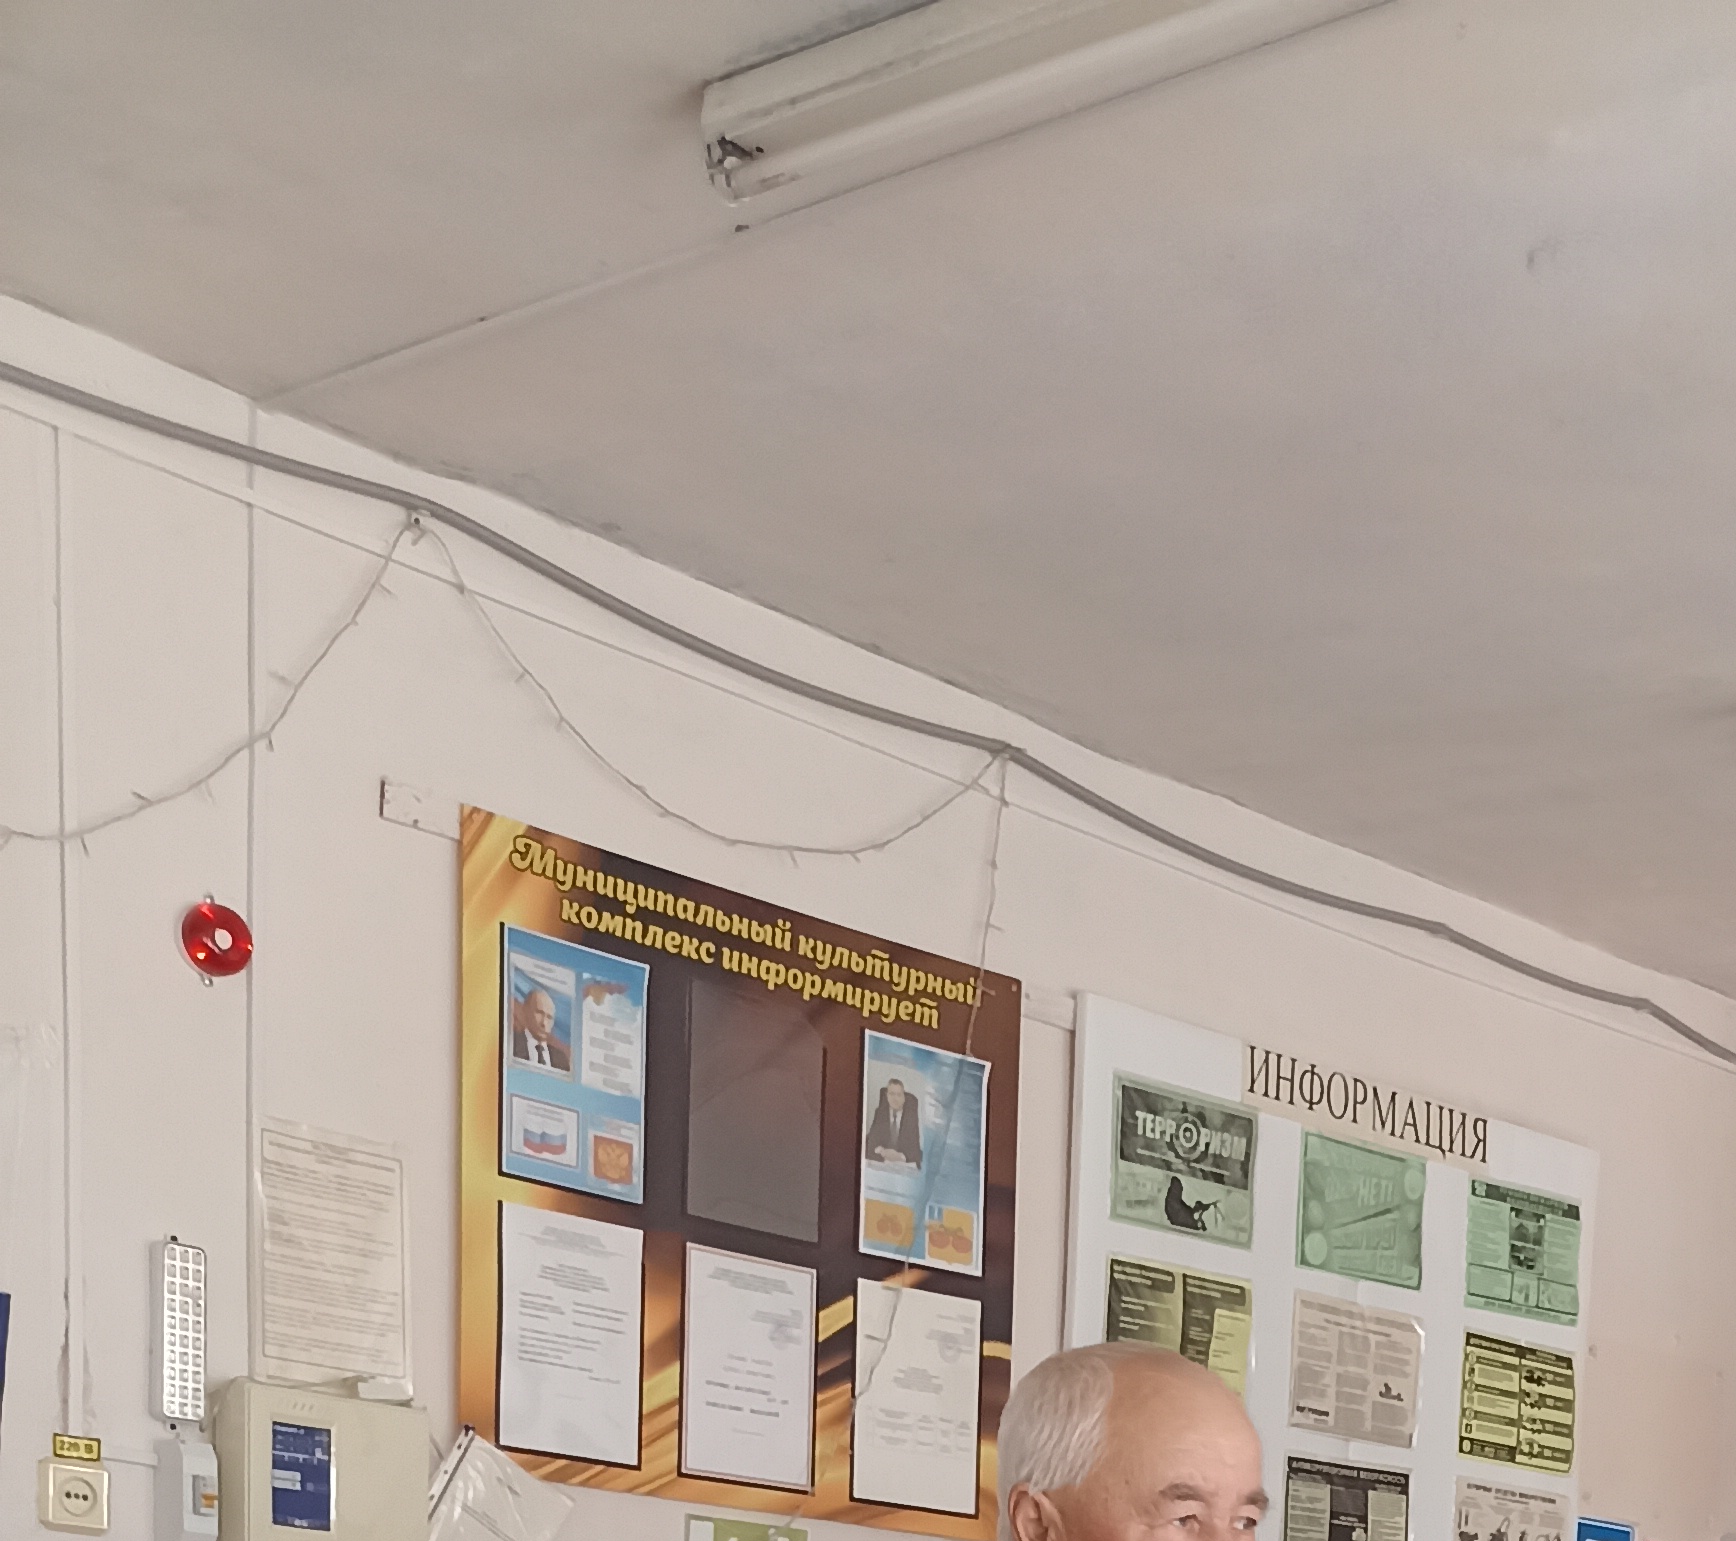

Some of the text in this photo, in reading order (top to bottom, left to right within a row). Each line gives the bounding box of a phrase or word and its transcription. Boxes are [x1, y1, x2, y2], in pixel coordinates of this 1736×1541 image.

[508, 834, 981, 1008] Муниципальный культурный
[560, 896, 940, 1030] комплекс информирует
[1135, 1110, 1247, 1162] ТЕРРОРИЗМ
[1248, 1044, 1488, 1164] ИНФОРМАЦИЯ
